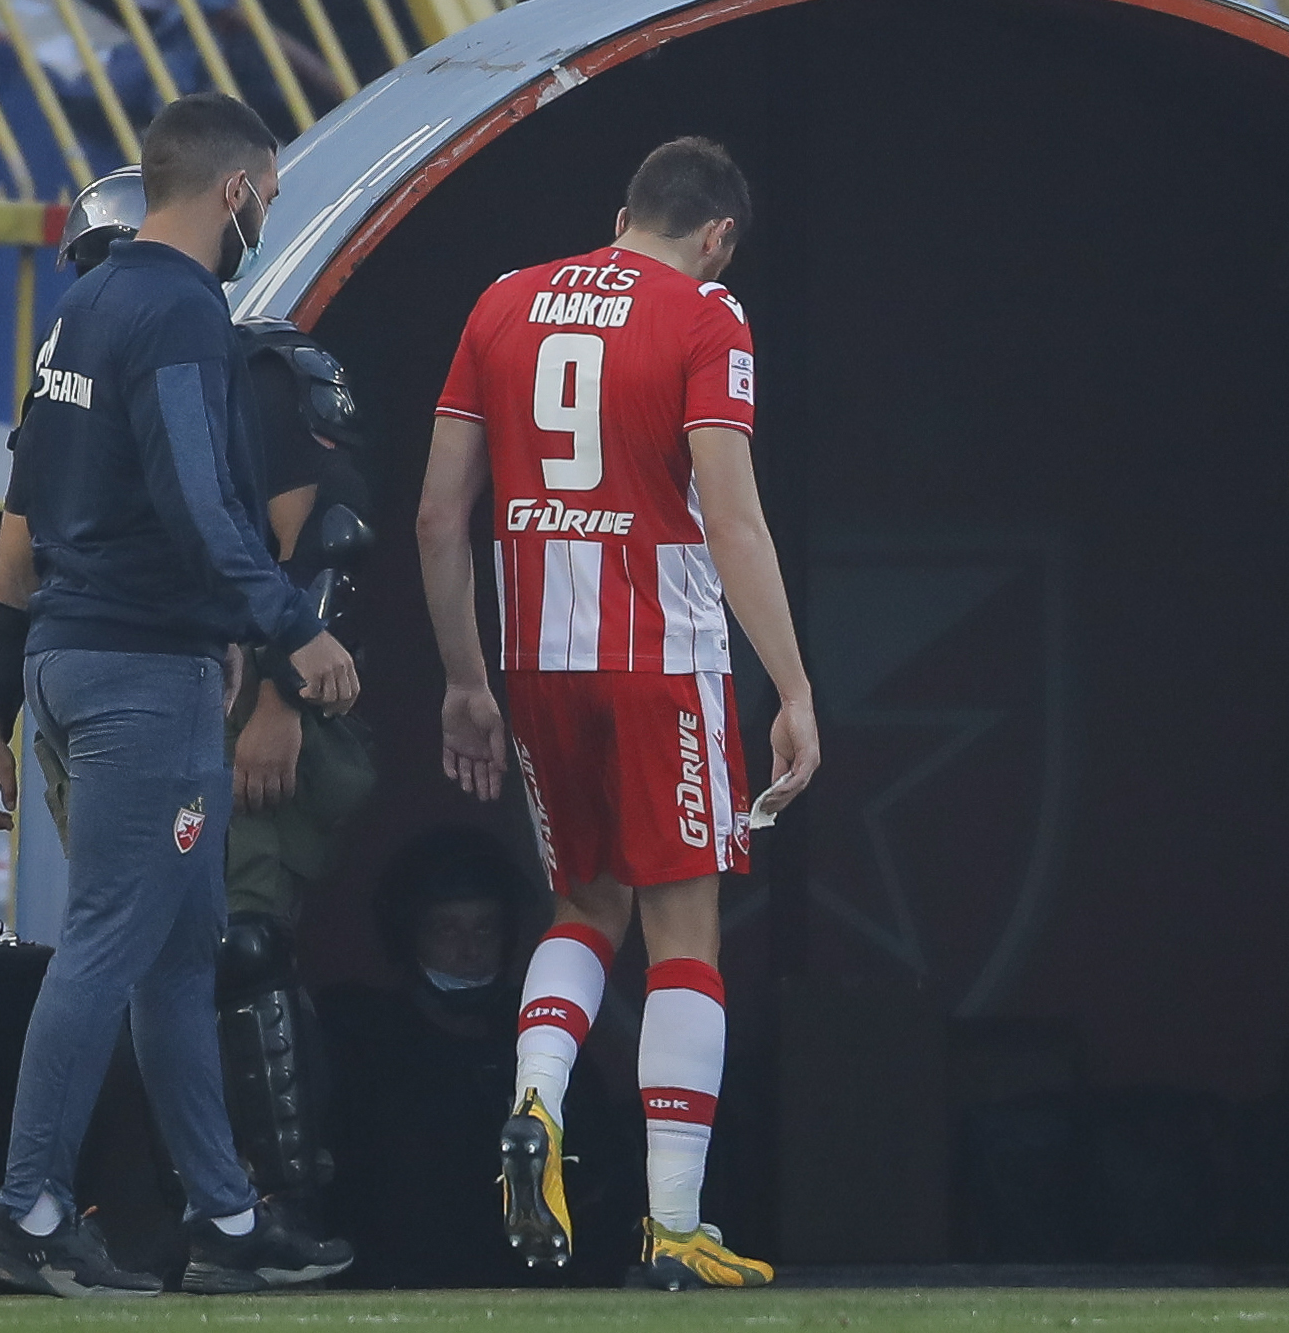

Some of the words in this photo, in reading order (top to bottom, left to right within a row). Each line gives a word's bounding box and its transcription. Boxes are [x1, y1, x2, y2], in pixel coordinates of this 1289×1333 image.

[550, 262, 641, 292] mts
[527, 291, 633, 329] ПАВКОВ
[532, 332, 605, 491] 9
